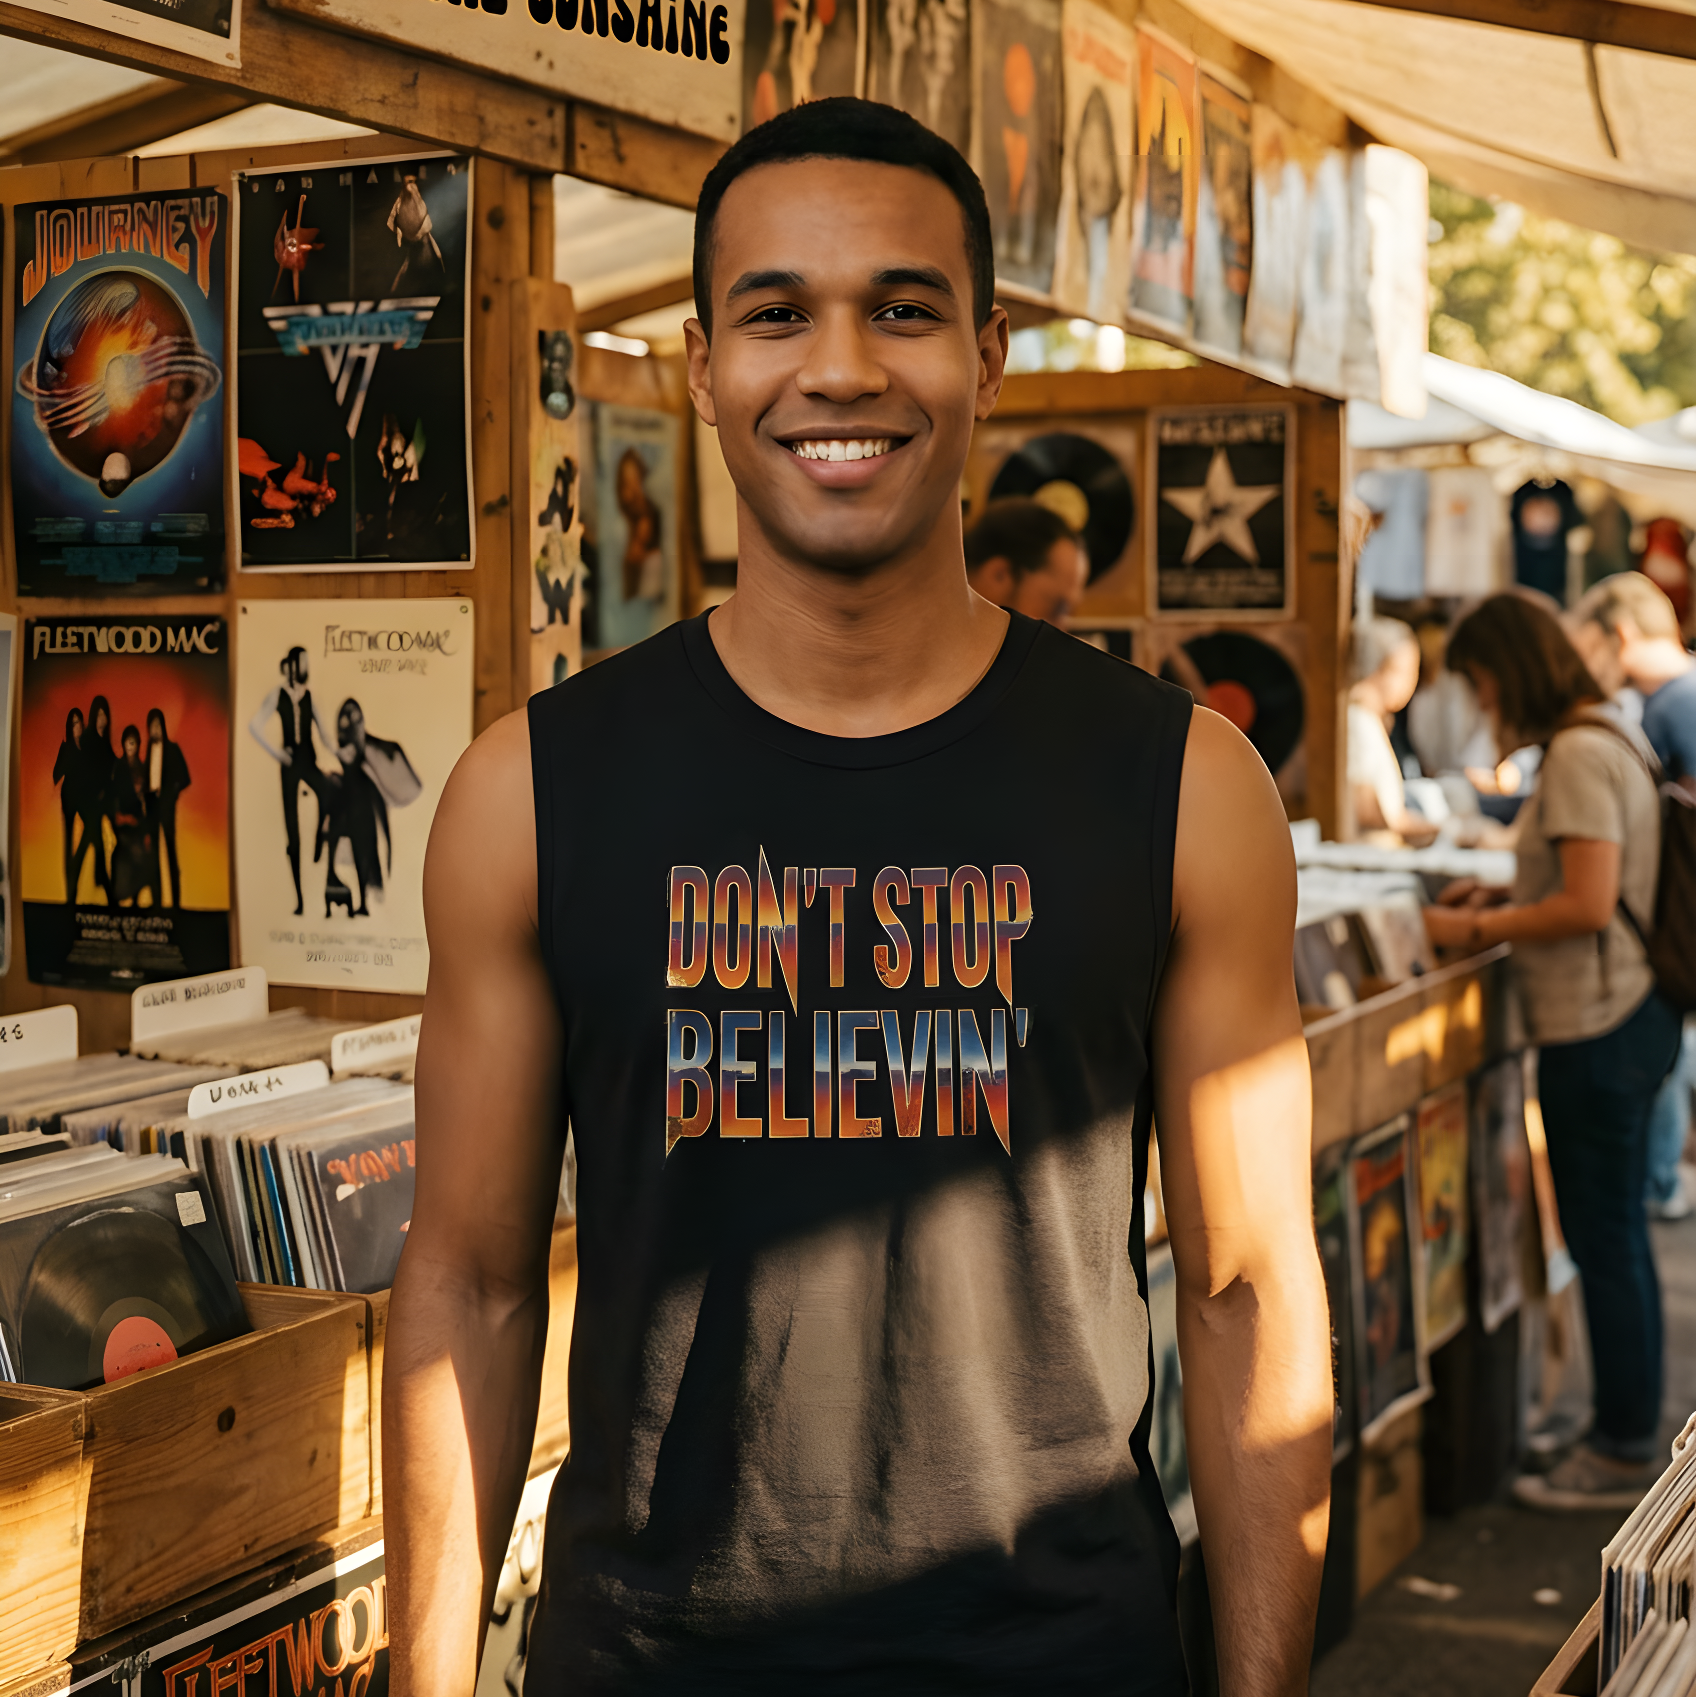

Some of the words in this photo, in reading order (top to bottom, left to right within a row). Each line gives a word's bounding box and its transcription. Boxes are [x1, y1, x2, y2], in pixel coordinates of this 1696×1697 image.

[22, 195, 218, 307] JOURNEY
[665, 844, 857, 1018] DON'T
[872, 864, 1034, 1023] STOP
[665, 1007, 1029, 1158] BELIEVIN'
